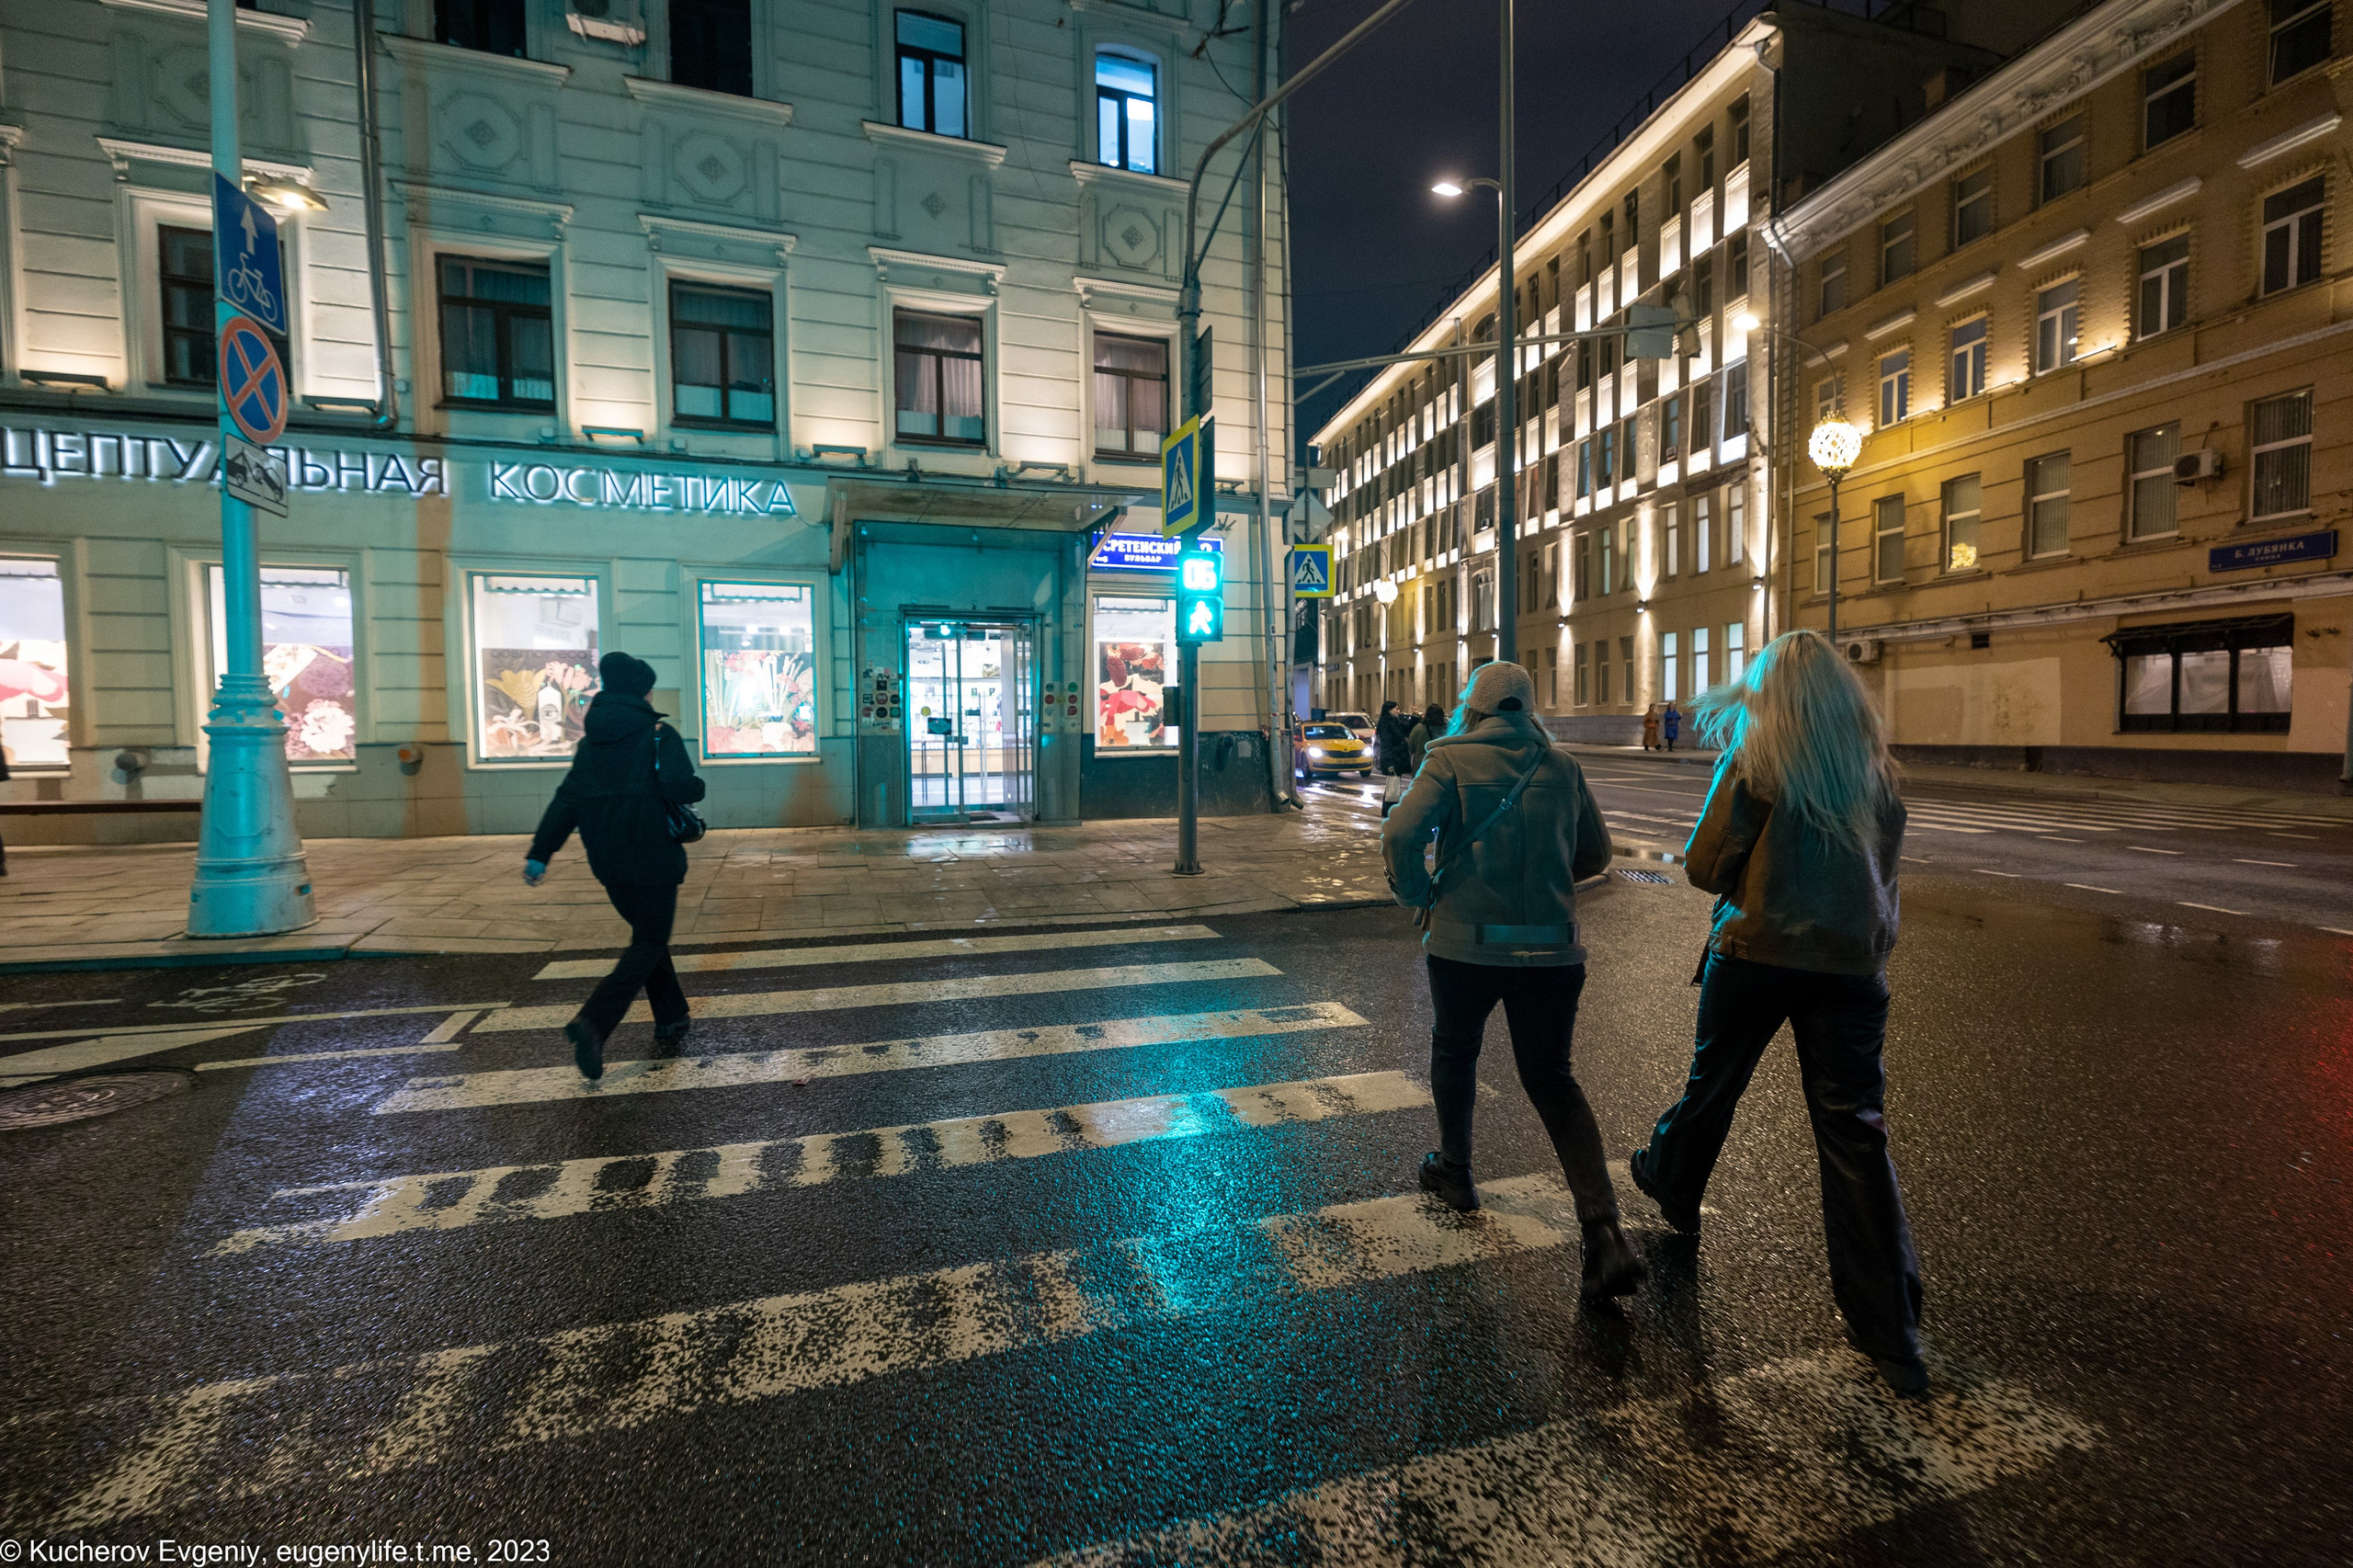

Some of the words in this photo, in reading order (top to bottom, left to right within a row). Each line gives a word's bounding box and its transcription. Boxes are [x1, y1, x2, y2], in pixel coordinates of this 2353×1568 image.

[0, 426, 449, 496] ЦЕПТУЛЬНАЯ
[489, 460, 798, 517] КОСМЕТИКА
[2234, 550, 2245, 559] Б.
[2247, 540, 2304, 557] ЛУБЯНКА
